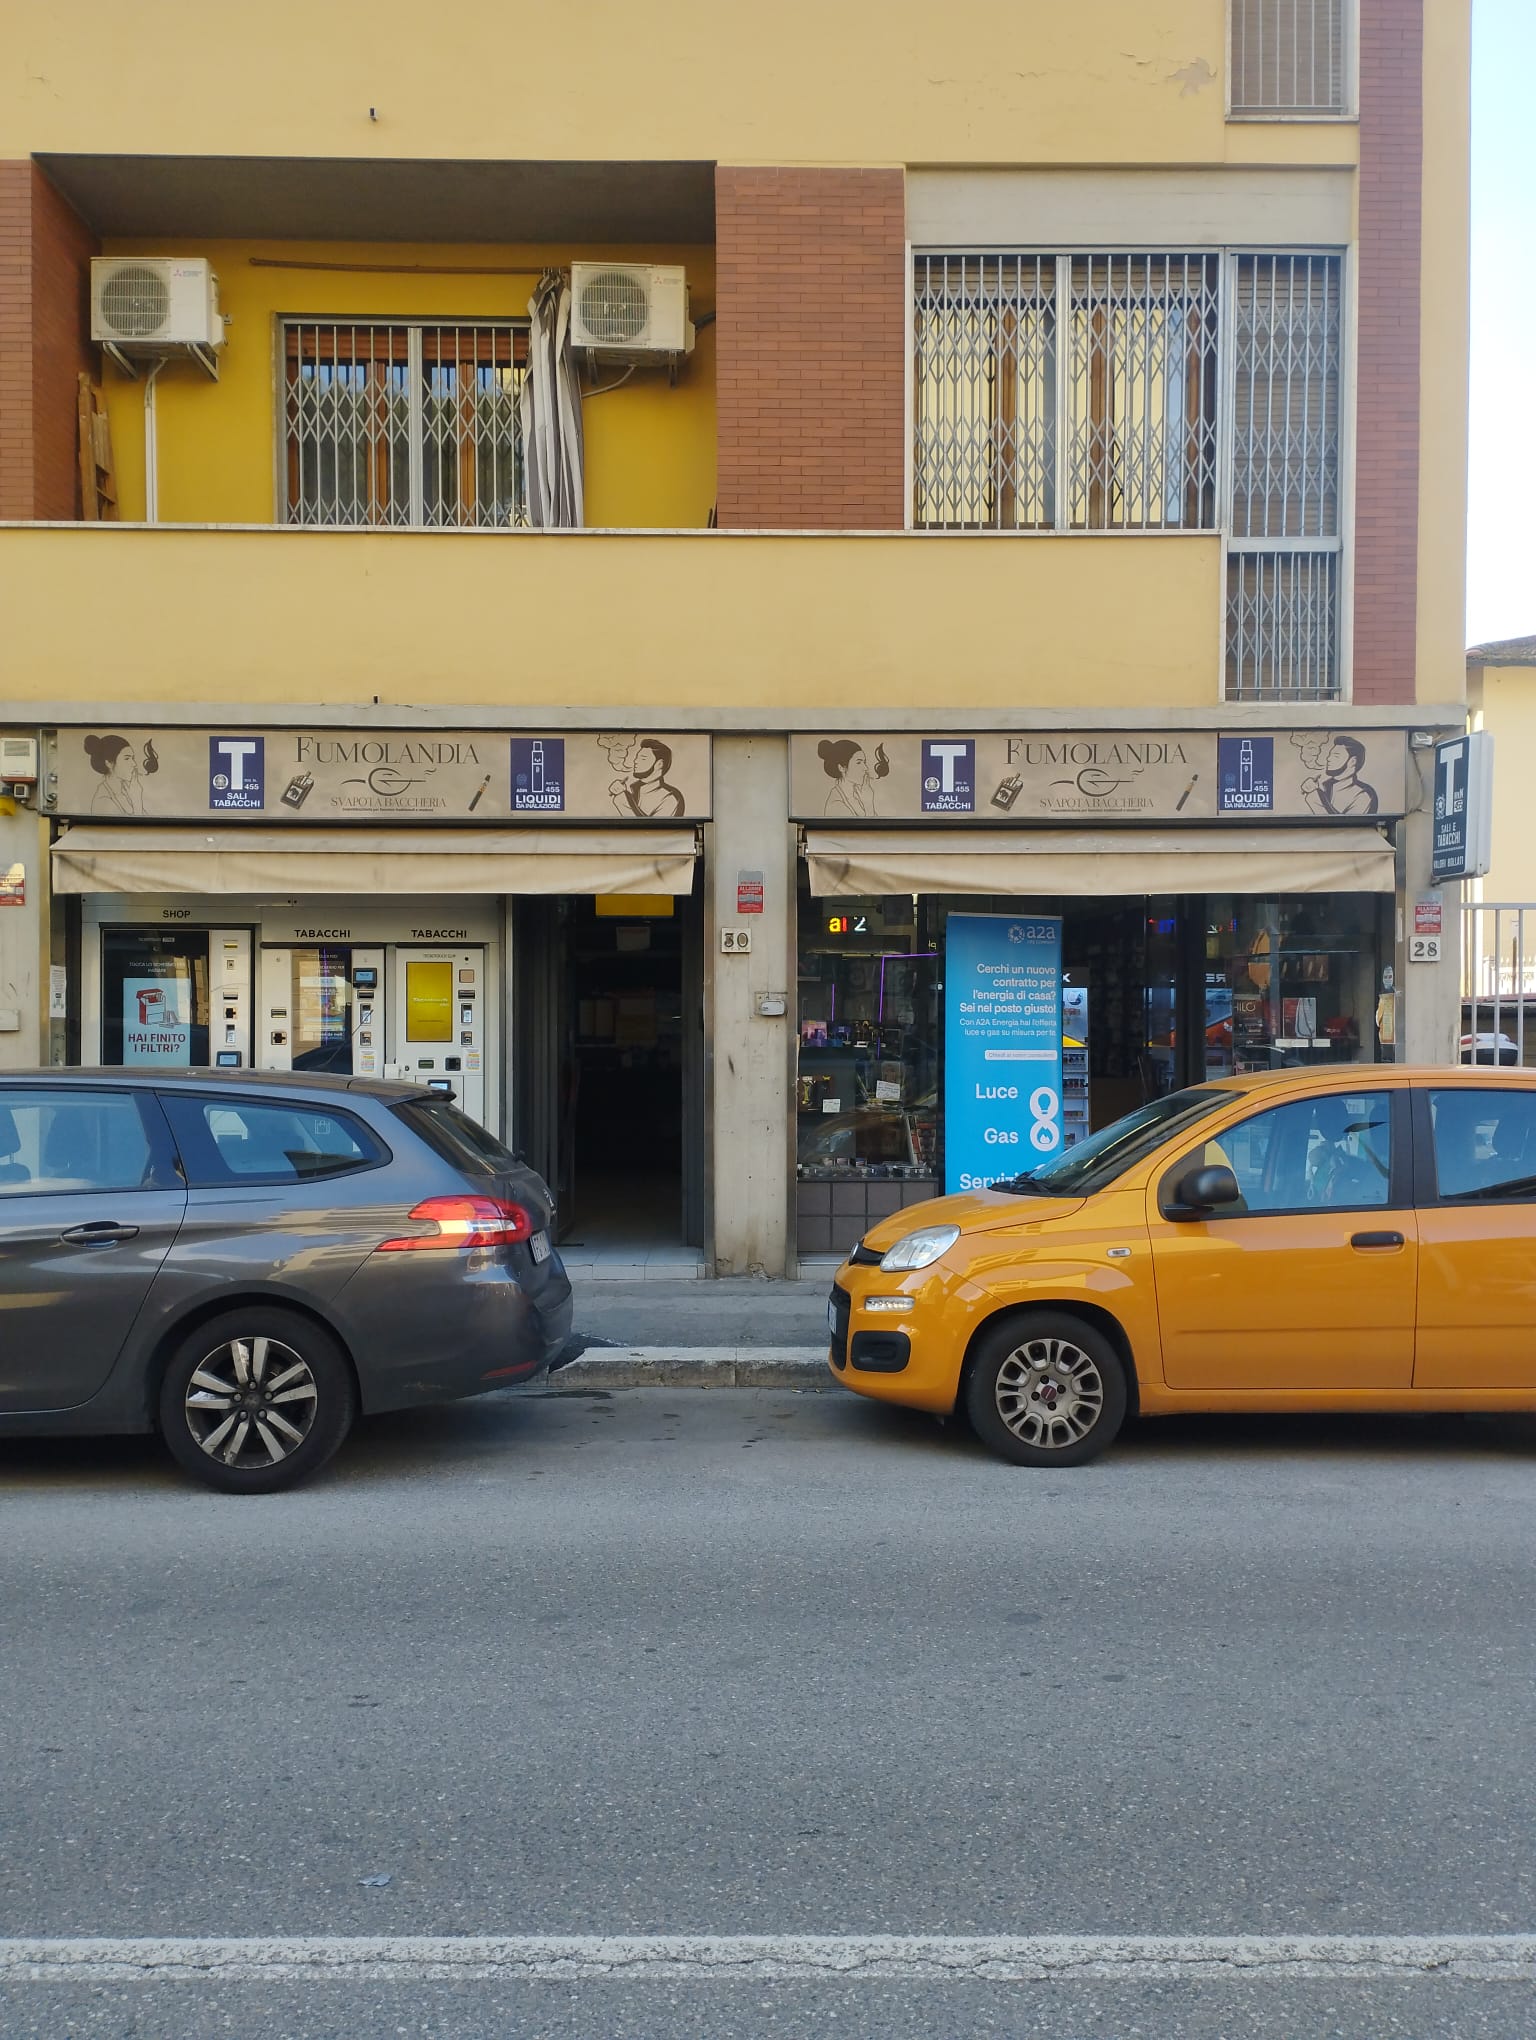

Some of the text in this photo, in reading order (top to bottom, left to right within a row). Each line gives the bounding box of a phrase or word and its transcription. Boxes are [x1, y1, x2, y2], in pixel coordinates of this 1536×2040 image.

[294, 736, 480, 764] FUMOLANDIA
[1003, 738, 1189, 765] FUMOLANDIA
[218, 741, 256, 790] T
[930, 744, 967, 793] T
[1440, 742, 1464, 817] T
[244, 783, 260, 791] 455
[955, 785, 970, 793] 455
[226, 792, 248, 800] SALI
[515, 794, 561, 804] LIQUIDI
[938, 795, 958, 803] SALI
[1224, 794, 1270, 803] LIQUIDI
[213, 800, 260, 808] TABACCHI
[1441, 822, 1457, 834] SALI E
[1437, 831, 1461, 848] TABACCHI
[162, 909, 191, 918] SHOP
[294, 929, 351, 938] TABACCHI
[411, 929, 467, 938] TABACCHI
[1026, 926, 1056, 939] a2a
[724, 932, 749, 948] 30
[1413, 941, 1438, 958] 28
[976, 963, 1056, 975] Cerchi un nuovo
[992, 978, 1056, 989] contratto per
[972, 989, 1056, 1002] l'energia di casa?
[959, 1002, 976, 1013] Sei
[977, 1002, 992, 1013] nel
[994, 1004, 1022, 1015] posto
[1023, 1003, 1056, 1016] giusto!
[959, 1018, 975, 1026] Con
[975, 1018, 991, 1026] A2A
[992, 1018, 1019, 1027] Energia
[1020, 1018, 1031, 1026] hai
[128, 1033, 186, 1043] HAI FINITO
[964, 1028, 980, 1036] luce
[986, 1029, 1000, 1037] gas
[1011, 1028, 1035, 1036] misura
[1036, 1029, 1048, 1037] per
[134, 1043, 180, 1053] I FILTRI?
[975, 1083, 1019, 1099] Luce
[983, 1127, 1019, 1144] Gas
[959, 1172, 1019, 1190] Servi
